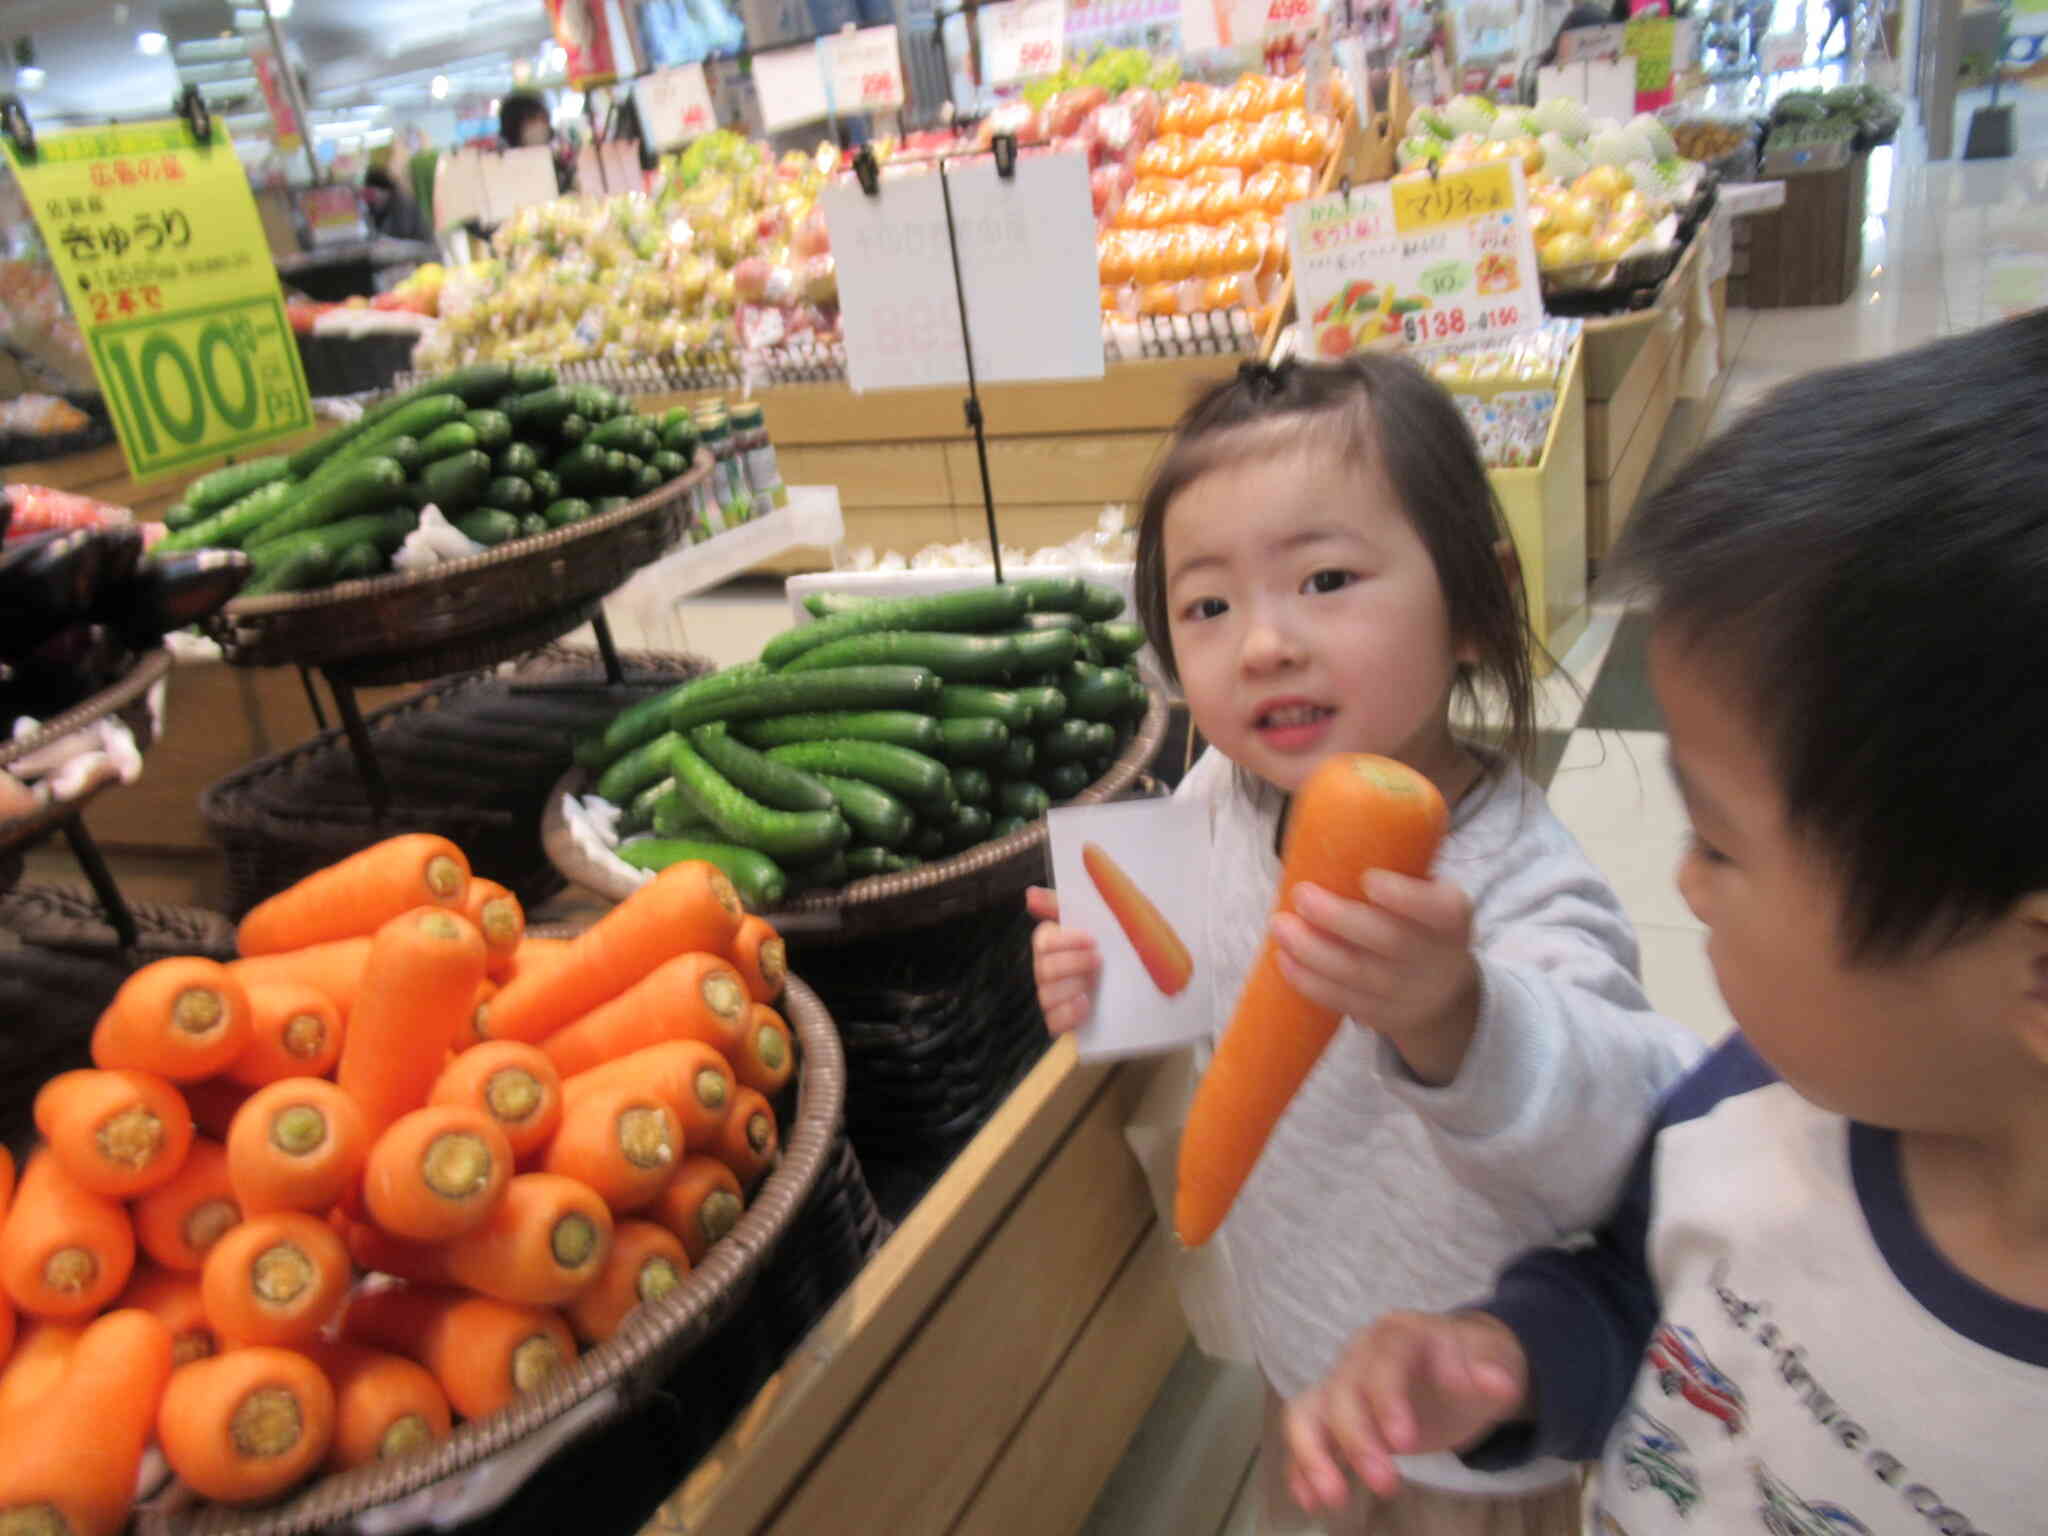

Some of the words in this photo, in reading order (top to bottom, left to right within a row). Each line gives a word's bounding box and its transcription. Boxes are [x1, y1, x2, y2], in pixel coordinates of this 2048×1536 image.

[61, 209, 191, 260] きゅうり
[89, 285, 162, 320] 2本で
[107, 323, 259, 455] 100
